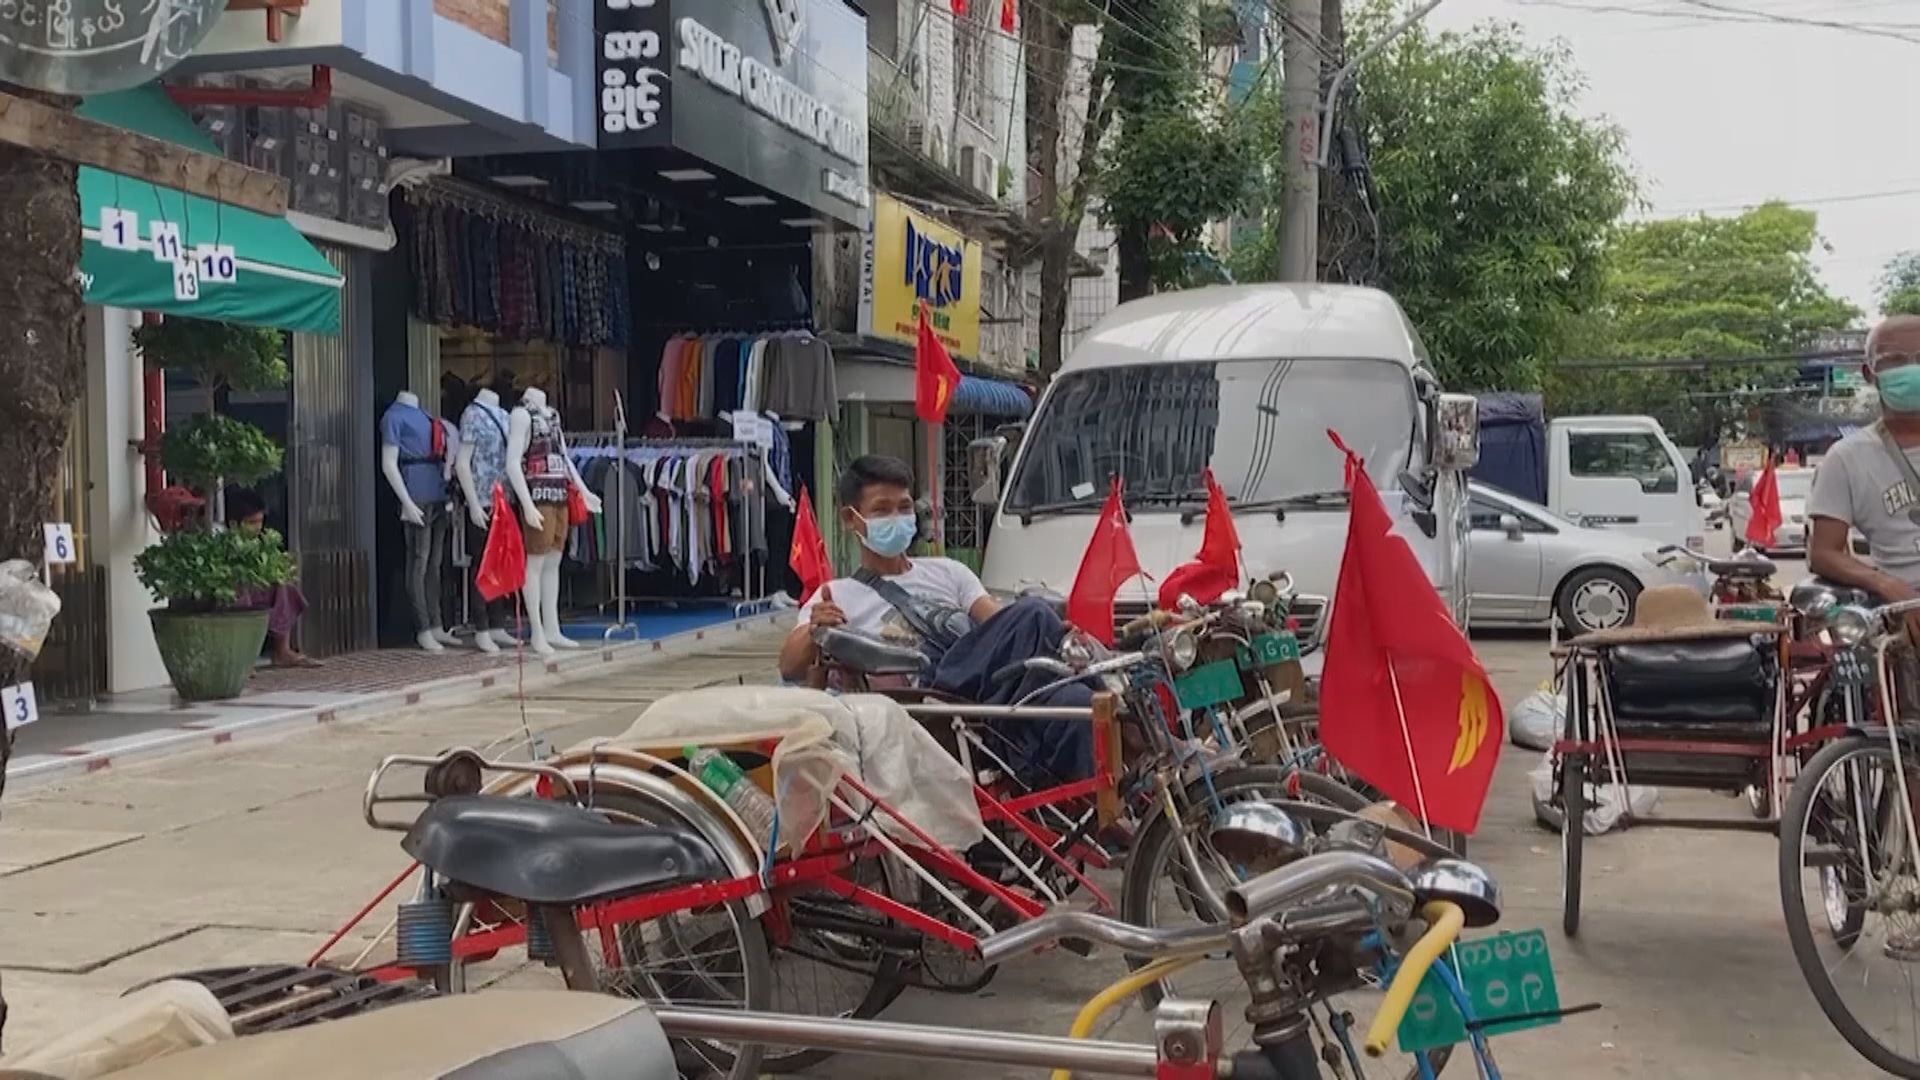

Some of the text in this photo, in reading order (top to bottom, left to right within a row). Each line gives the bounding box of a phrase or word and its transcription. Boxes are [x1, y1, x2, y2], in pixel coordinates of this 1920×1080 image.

[112, 220, 124, 245] 1
[156, 233, 179, 259] 11
[201, 255, 234, 279] 10
[177, 271, 197, 297] 13
[55, 535, 68, 559] 6
[15, 697, 29, 722] 3
